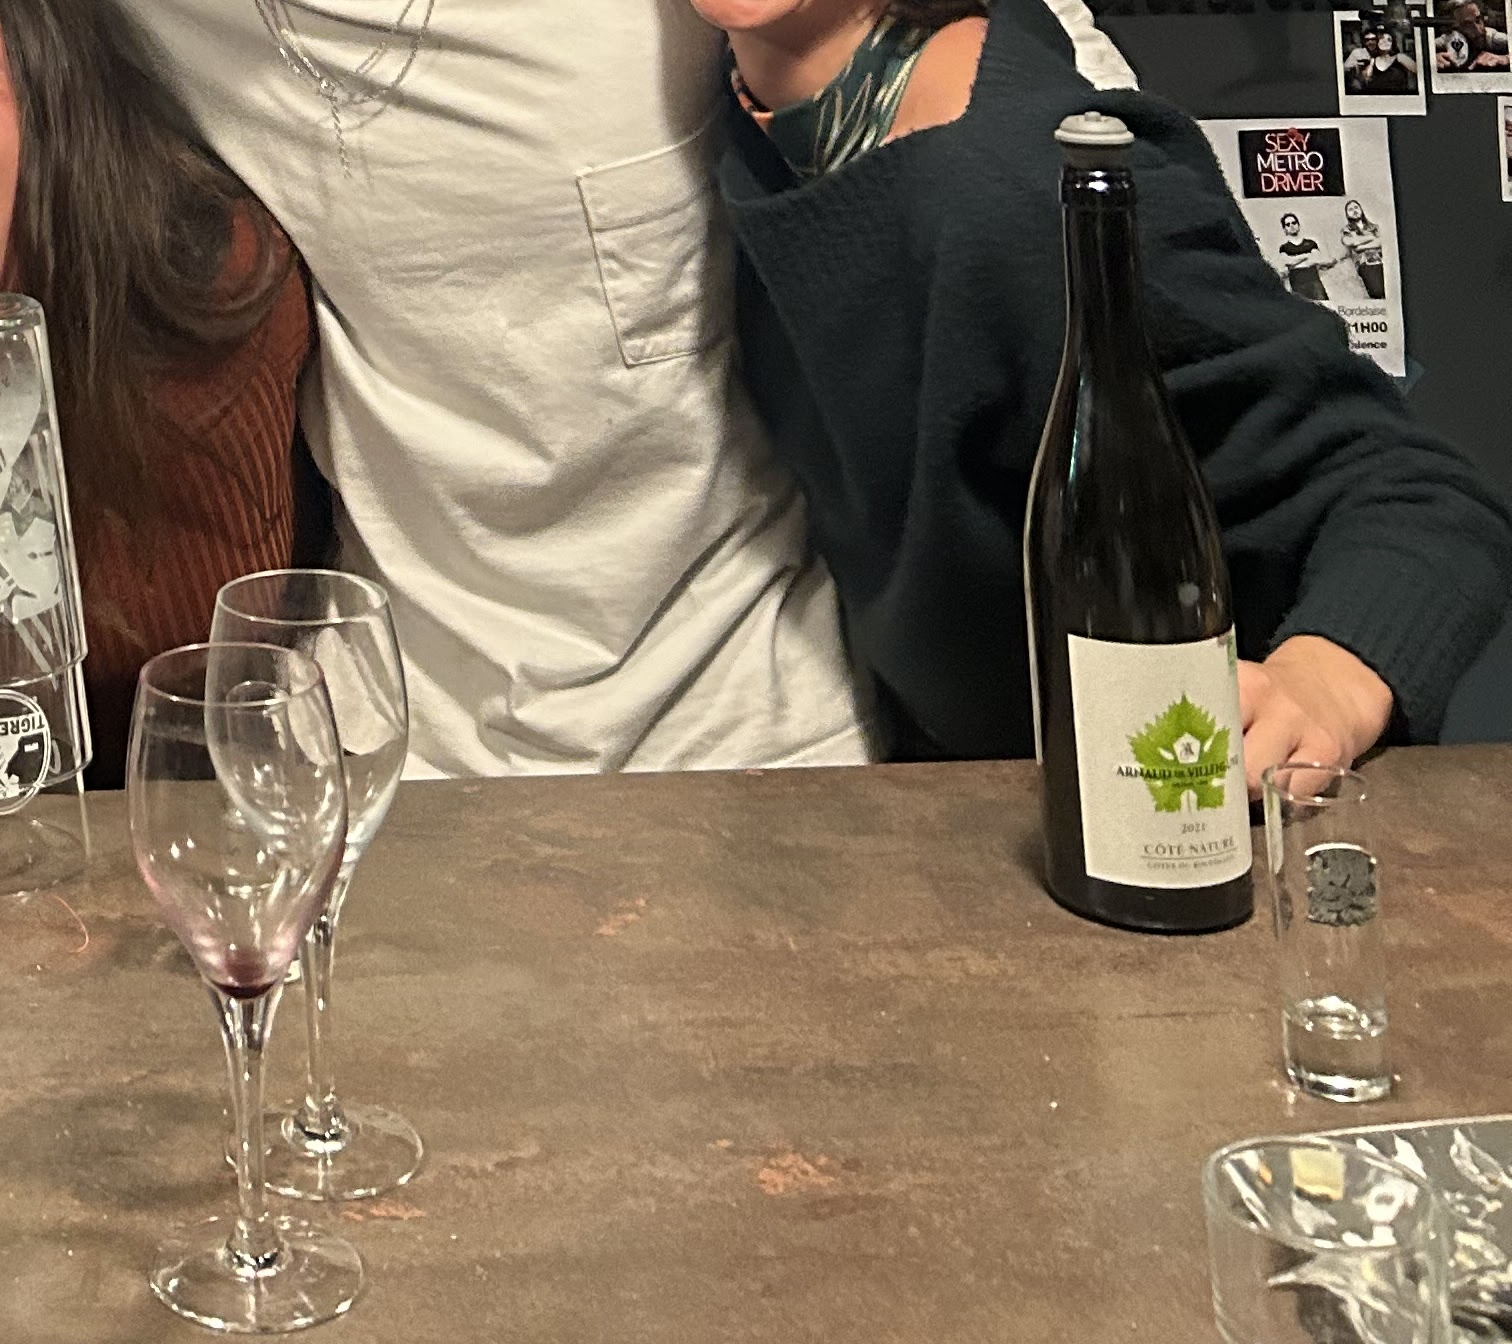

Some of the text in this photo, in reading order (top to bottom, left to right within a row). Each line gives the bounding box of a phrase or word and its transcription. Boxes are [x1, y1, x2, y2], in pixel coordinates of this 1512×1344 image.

[1265, 132, 1312, 153] SEXY
[1257, 151, 1324, 173] METRO
[1261, 171, 1325, 194] DRIVER
[1350, 320, 1389, 335] 1H00
